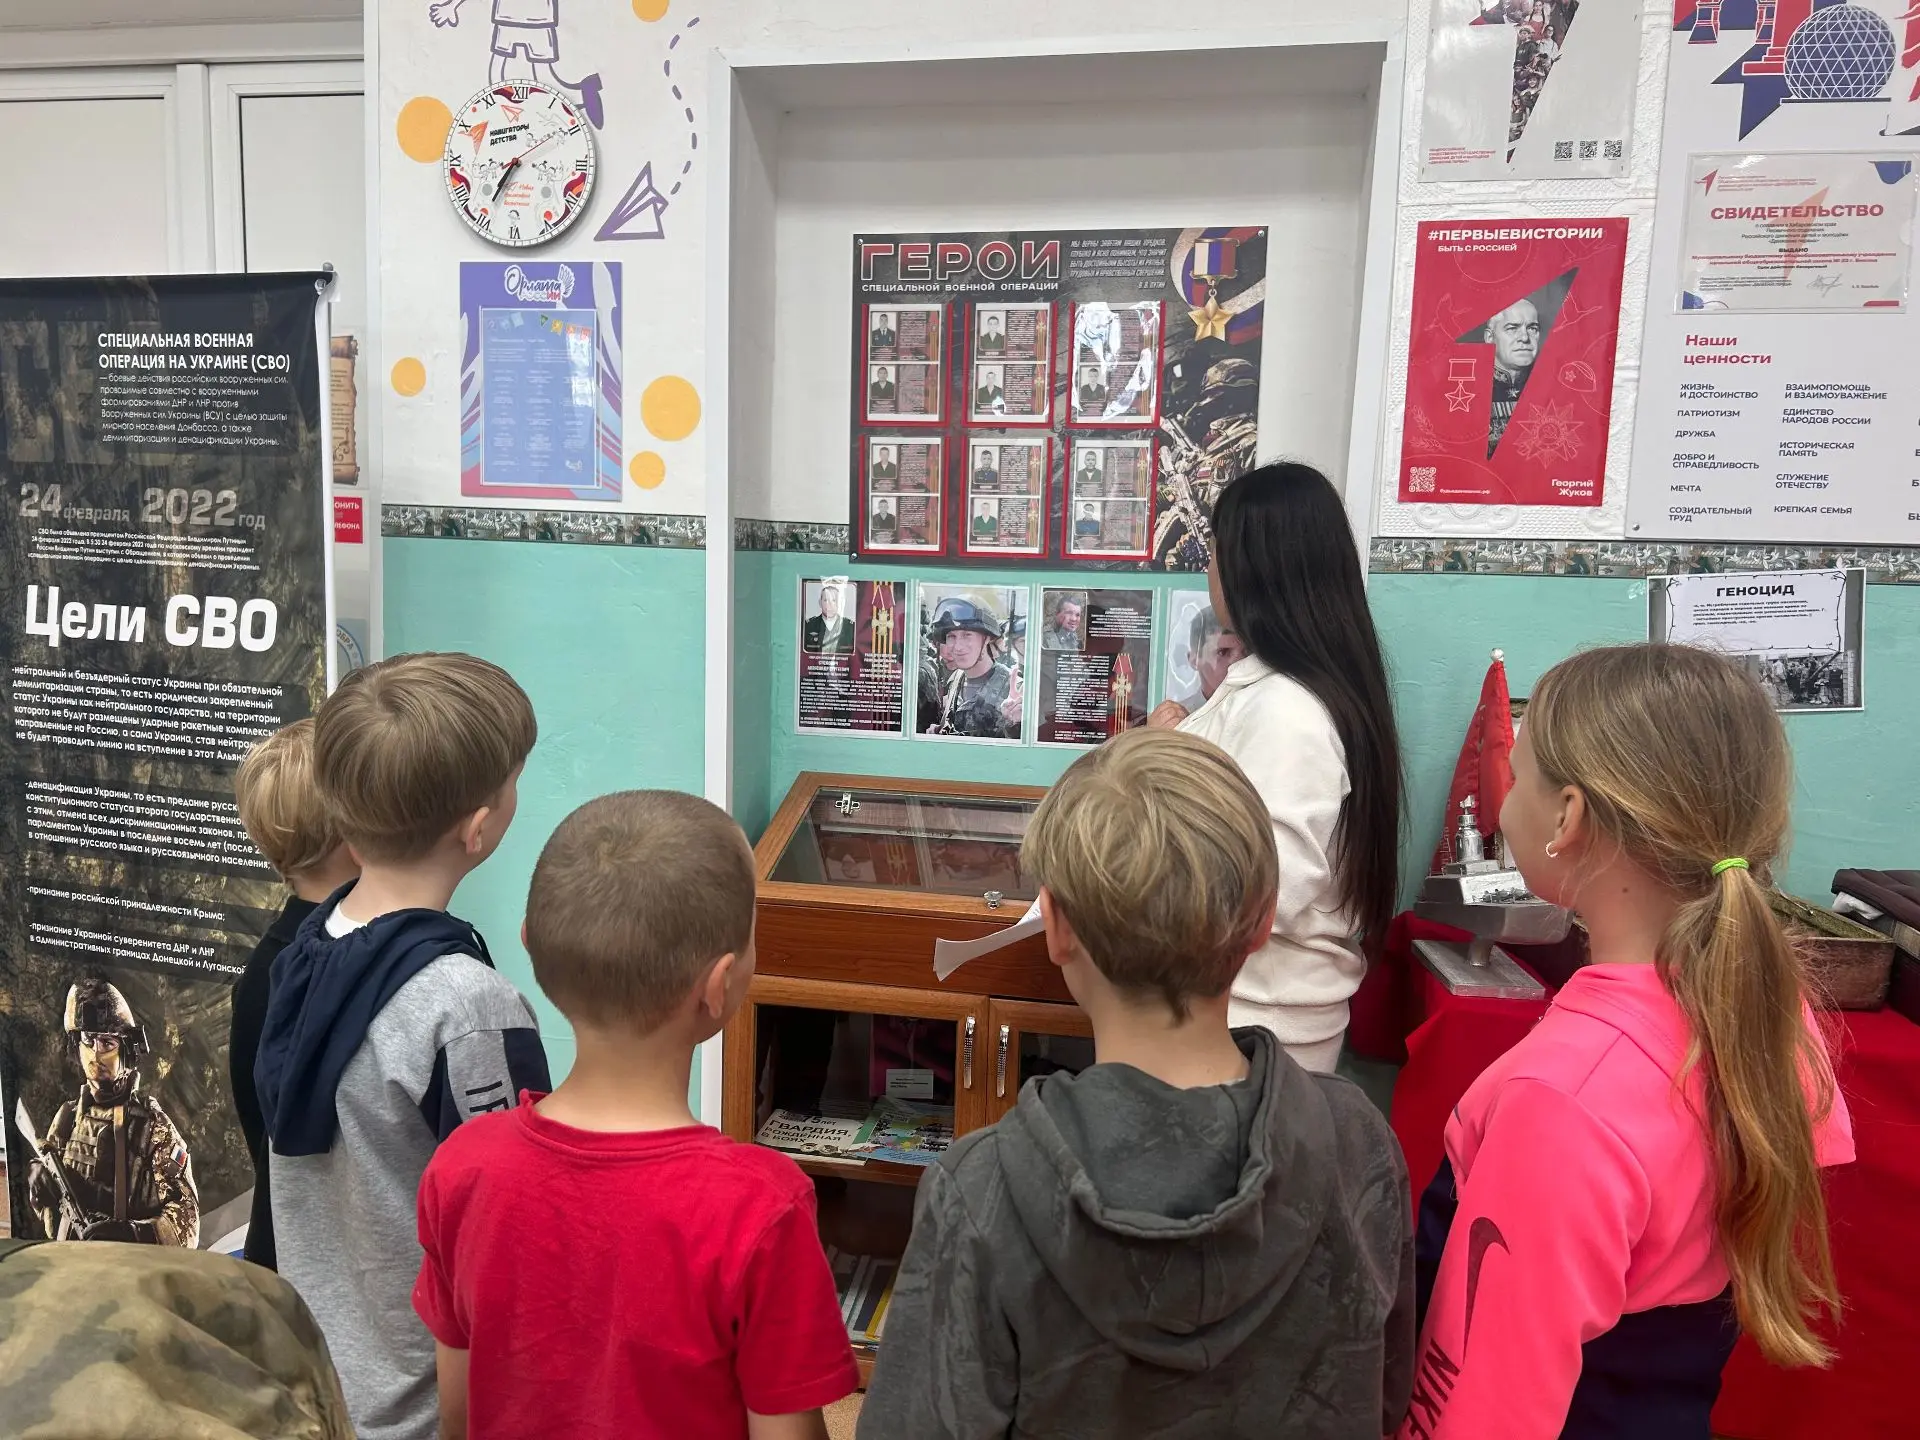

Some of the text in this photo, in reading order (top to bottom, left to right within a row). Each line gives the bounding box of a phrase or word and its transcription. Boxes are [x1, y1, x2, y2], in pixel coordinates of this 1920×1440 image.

[490, 135, 516, 146] ДЕТСТВА
[1711, 204, 1883, 220] СВИДЕТЕЛЬСТВО
[1428, 228, 1602, 241] #ПЕРВЫЕВИСТОРИИ
[1472, 243, 1517, 252] РОССИЕЙ
[860, 240, 1059, 281] ГЕРОИ
[862, 282, 1058, 293] СПЕЦИАЛЬНОЙ ВОЕННОЙ ОПЕРАЦИИ
[98, 333, 253, 349] СПЕЦИАЛЬНАЯ ВОЕННАЯ
[1685, 335, 1738, 346] Наши
[99, 355, 290, 373] ОПЕРАЦИЯ НА УКРАИНЕ (СВО)
[1684, 353, 1771, 365] ценности
[1680, 383, 1715, 391] ЖИЗНЬ
[1785, 383, 1871, 392] ВЗАИМОПОМОЩЬ
[1794, 392, 1887, 400] ВЗАИМОУВАЖЕНИЕ
[1782, 416, 1871, 425] НАРОДОВ РОССИИ
[1675, 430, 1716, 438] ДРУЖБА
[1779, 442, 1854, 450] ИСТОРИЧЕСКАЯ
[1673, 454, 1705, 462] ДОБРО
[1672, 462, 1759, 470] СПРАВЕДЛИВОСТЬ
[1552, 478, 1593, 489] Георгий
[1775, 481, 1829, 489] ОТЕЧЕСТВУ
[1559, 488, 1592, 497] Жуков
[19, 483, 265, 530] 24 февраля 2022 год
[1669, 506, 1752, 515] СОЗИДАТЕЛЬНЫЙ
[1774, 506, 1817, 514] КРЕПКАЯ
[1669, 514, 1692, 523] ТРУД
[1717, 584, 1795, 597] ГЕНОЦИД
[26, 585, 277, 652] Цели СВО
[75, 671, 130, 685] безъядерный
[132, 676, 162, 688] статус
[163, 677, 202, 690] Украины
[203, 683, 220, 694] при
[222, 683, 283, 697] обязательной
[13, 680, 84, 694] демилитаризации
[86, 686, 118, 698] страны,
[133, 689, 152, 699] есть
[155, 690, 208, 704] юридически
[210, 696, 273, 710] закрепленный
[13, 692, 281, 725] статус Украины как нейтрального государства, на территории
[14, 705, 275, 737] которого не будут размещены ударные ракетные комплексы
[15, 718, 73, 732] направленные
[87, 724, 121, 737] Россию,
[130, 730, 153, 740] сама
[155, 730, 194, 744] Украина,
[196, 736, 215, 746] став
[16, 730, 25, 739] не
[27, 731, 51, 743] будет
[52, 734, 95, 748] проводить
[97, 740, 123, 751] линию
[125, 742, 135, 750] на
[137, 744, 186, 757] вступление
[195, 750, 215, 759] этот
[94, 787, 132, 800] Украины,
[134, 792, 144, 800] то
[147, 793, 166, 804] есть
[168, 796, 209, 809] предание
[211, 802, 240, 815] русск
[26, 793, 242, 826] конституционного статуса второго государственно
[33, 807, 55, 817] этим,
[57, 810, 87, 821] отмена
[89, 813, 108, 823] всех
[109, 815, 197, 833] дискриминационных
[198, 825, 236, 839] законов,
[27, 818, 81, 833] парламентом
[83, 823, 119, 838] Украины
[127, 831, 172, 846] последние
[174, 836, 205, 848] восемь
[207, 840, 221, 849] лет
[223, 841, 252, 854] (после
[34, 832, 79, 847] отношении
[80, 838, 118, 851] русского
[119, 842, 143, 853] языка
[152, 846, 220, 864] русскоязычного
[222, 855, 271, 870] населения;
[72, 891, 119, 906] российской
[122, 897, 192, 917] принадлежности
[194, 907, 225, 921] Крыма;
[74, 927, 112, 942] Украиной
[114, 935, 171, 951] суверенитета
[173, 943, 190, 954] ДНР
[199, 947, 215, 958] ЛНР
[36, 936, 111, 955] административных
[113, 947, 151, 961] границах
[152, 951, 194, 968] Донецкой
[203, 960, 246, 976] Луганской
[769, 1120, 851, 1137] ГВАРДИЯ,
